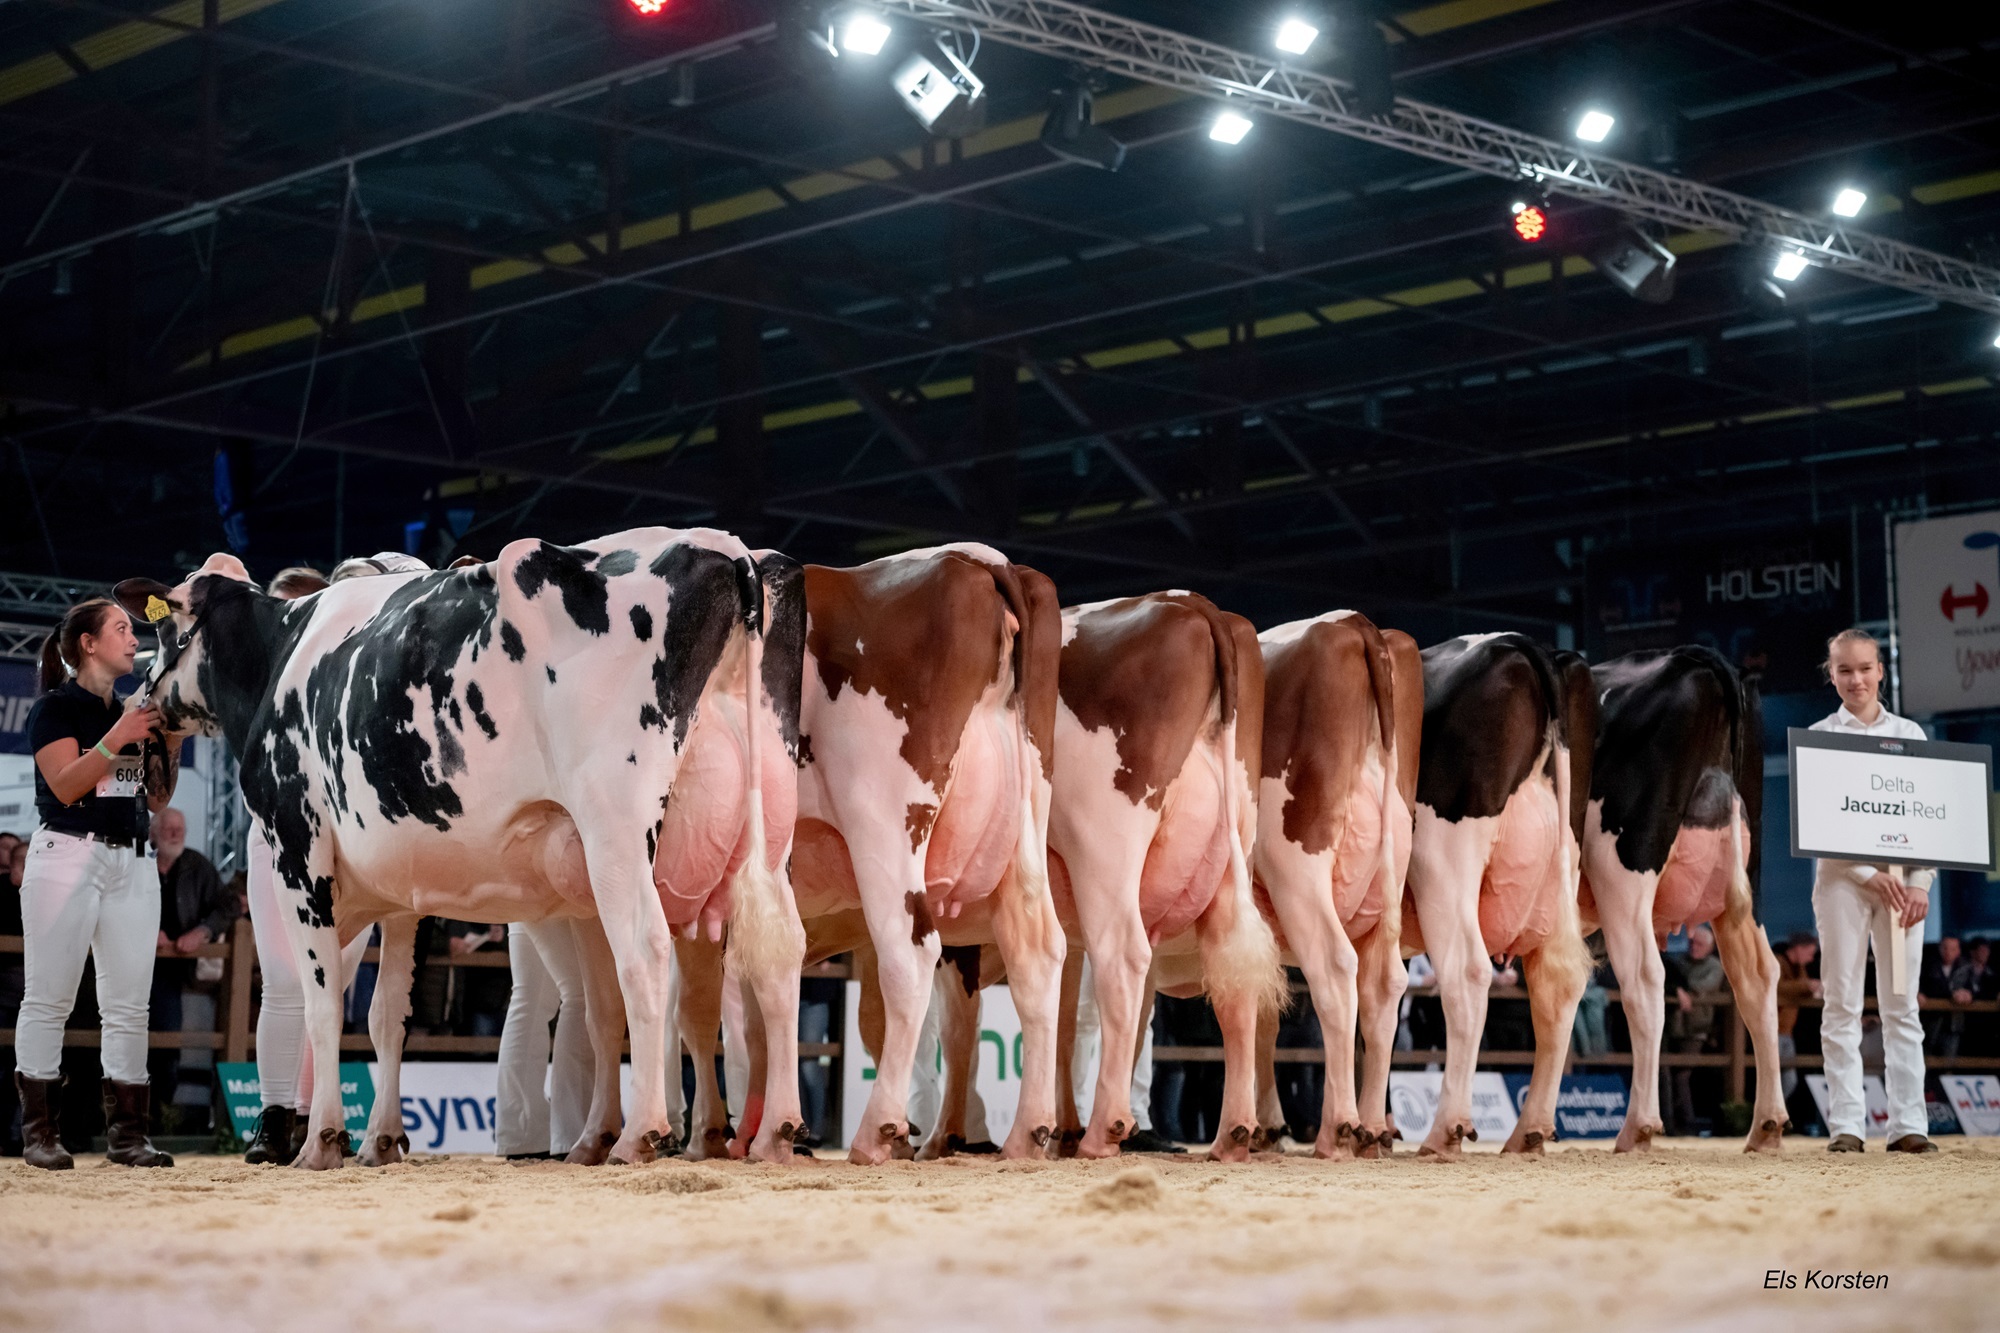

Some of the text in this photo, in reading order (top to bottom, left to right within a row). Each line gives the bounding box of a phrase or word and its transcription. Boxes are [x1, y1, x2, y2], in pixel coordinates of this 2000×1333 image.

[1706, 561, 1841, 602] HOLSTEIN
[1871, 774, 1915, 794] Delta
[1841, 795, 1946, 820] Jacuzzi-Red
[1880, 834, 1899, 843] CRV
